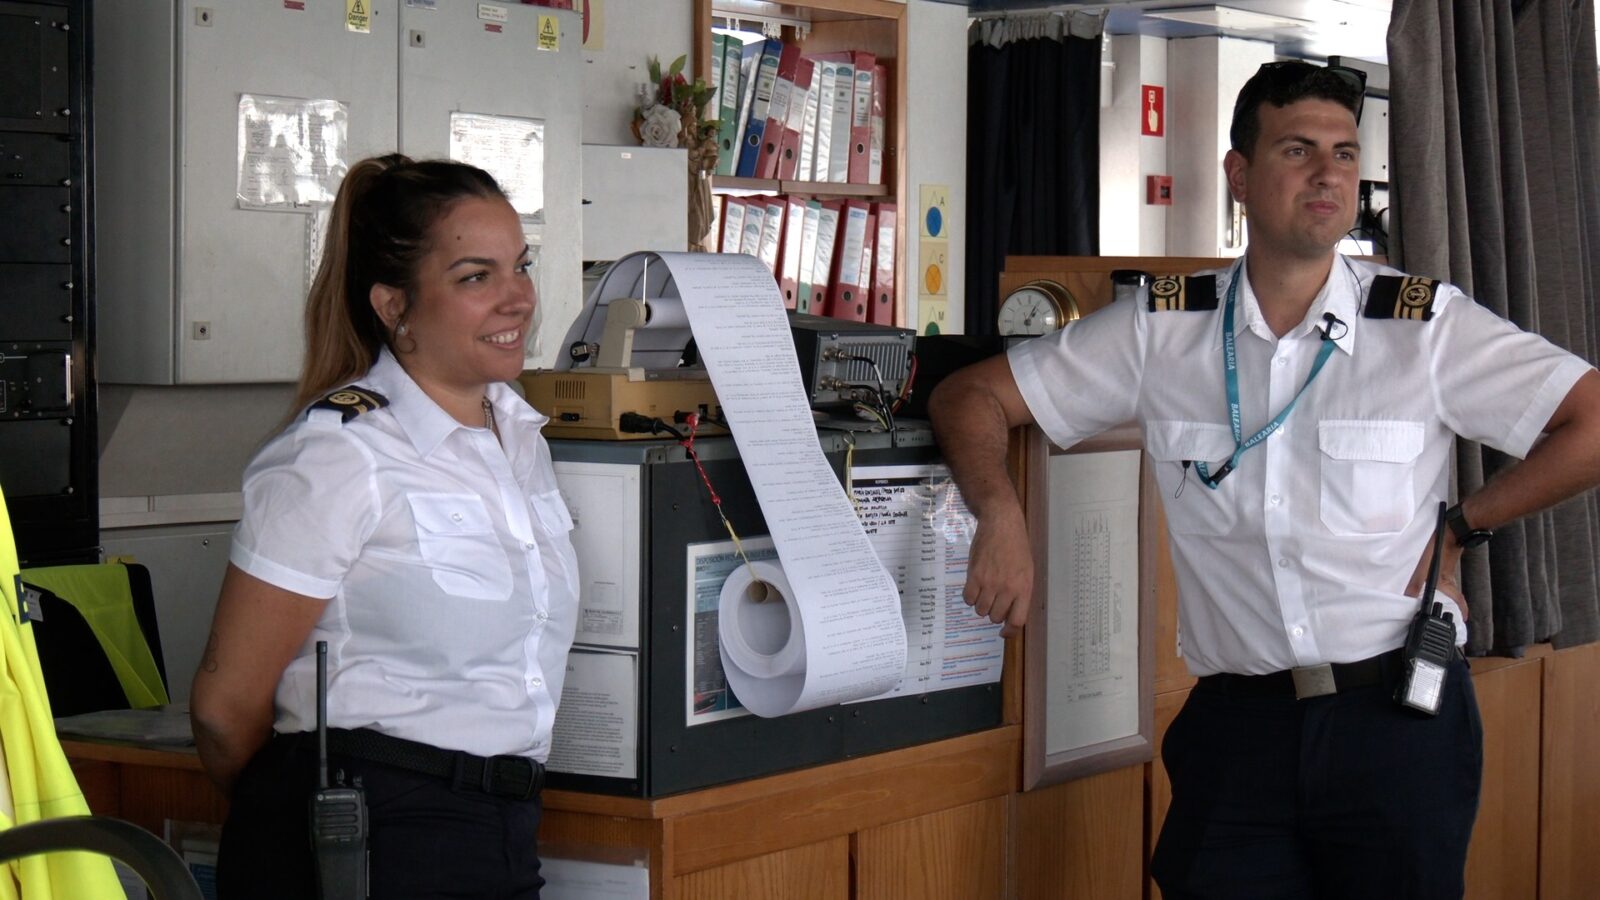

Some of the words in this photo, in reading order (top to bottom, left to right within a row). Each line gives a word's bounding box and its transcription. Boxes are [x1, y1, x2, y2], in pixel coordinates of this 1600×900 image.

[348, 13, 368, 24] Danger
[539, 33, 557, 43] Danger
[1225, 331, 1236, 370] BALEARIA
[1244, 421, 1280, 448] BALEARIA
